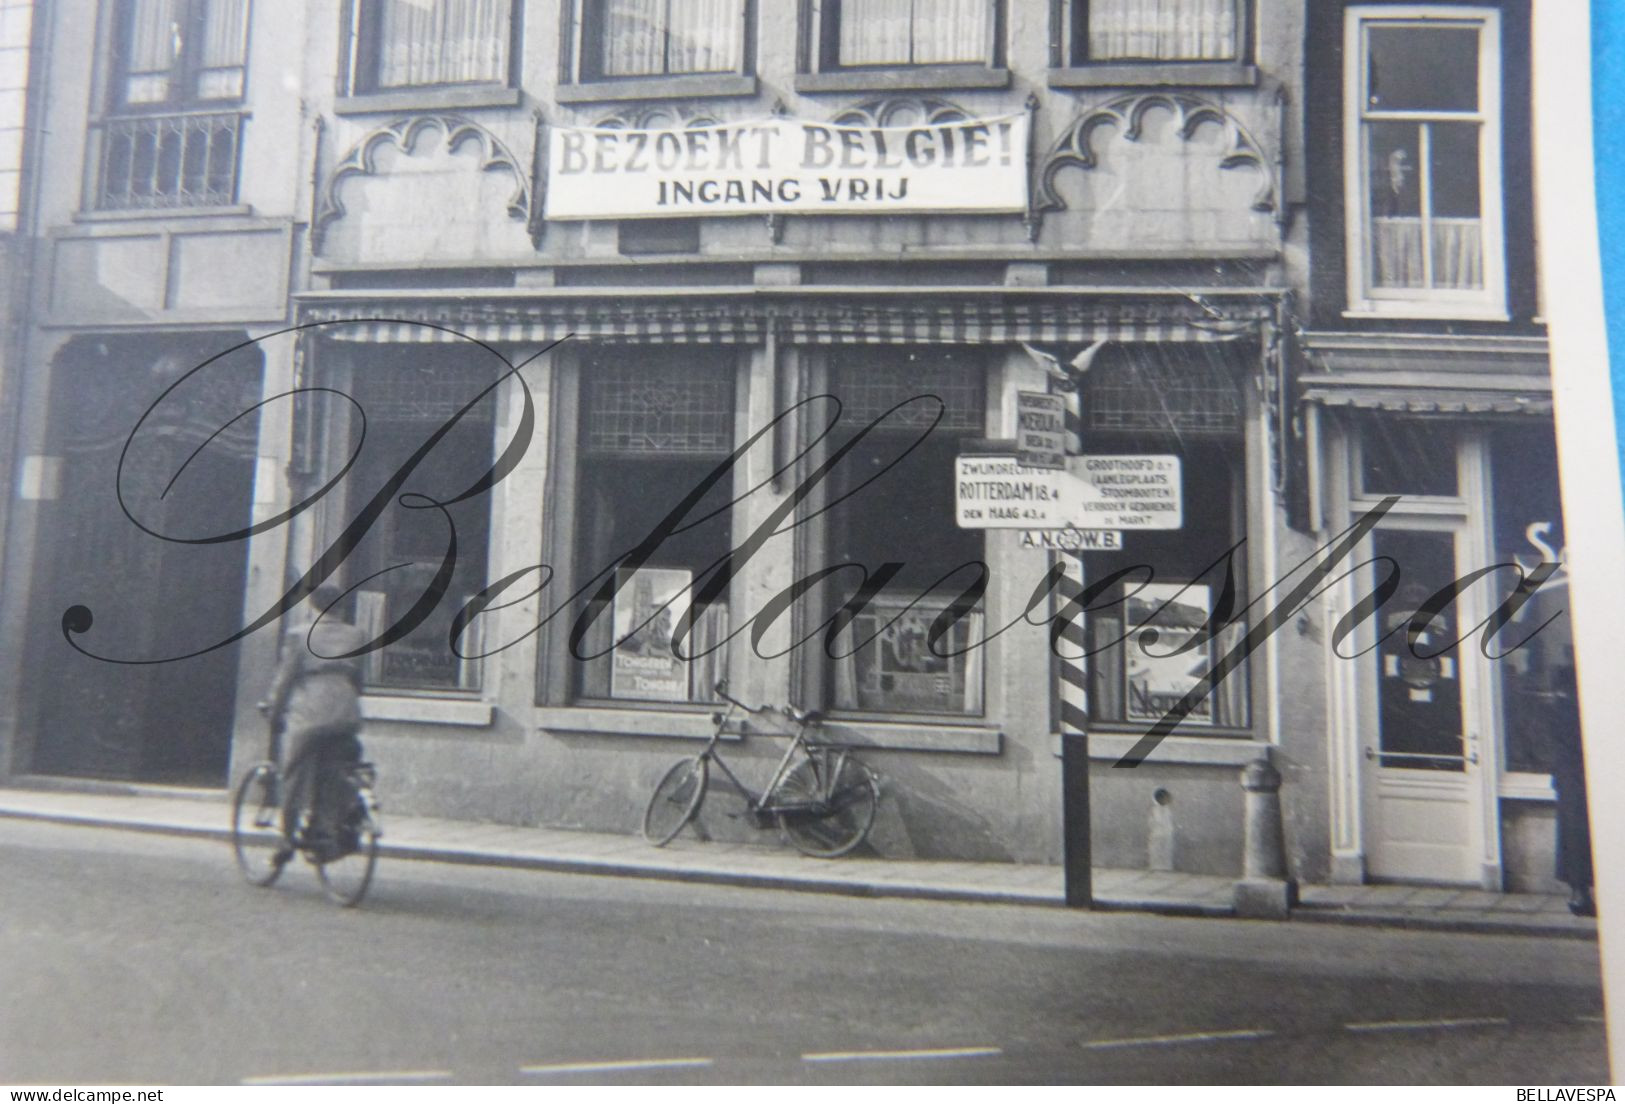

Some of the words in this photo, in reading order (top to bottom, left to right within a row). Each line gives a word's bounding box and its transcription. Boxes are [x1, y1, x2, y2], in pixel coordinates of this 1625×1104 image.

[558, 127, 780, 175] BEZOEKT
[800, 123, 1012, 170] BELGIE!
[657, 178, 801, 205] INGANG
[818, 178, 909, 201] VRIJ
[960, 481, 1032, 501] ROTTERDAM
[963, 509, 983, 519] DEN
[989, 506, 1020, 519] HAAG
[1118, 515, 1152, 525] MARKT
